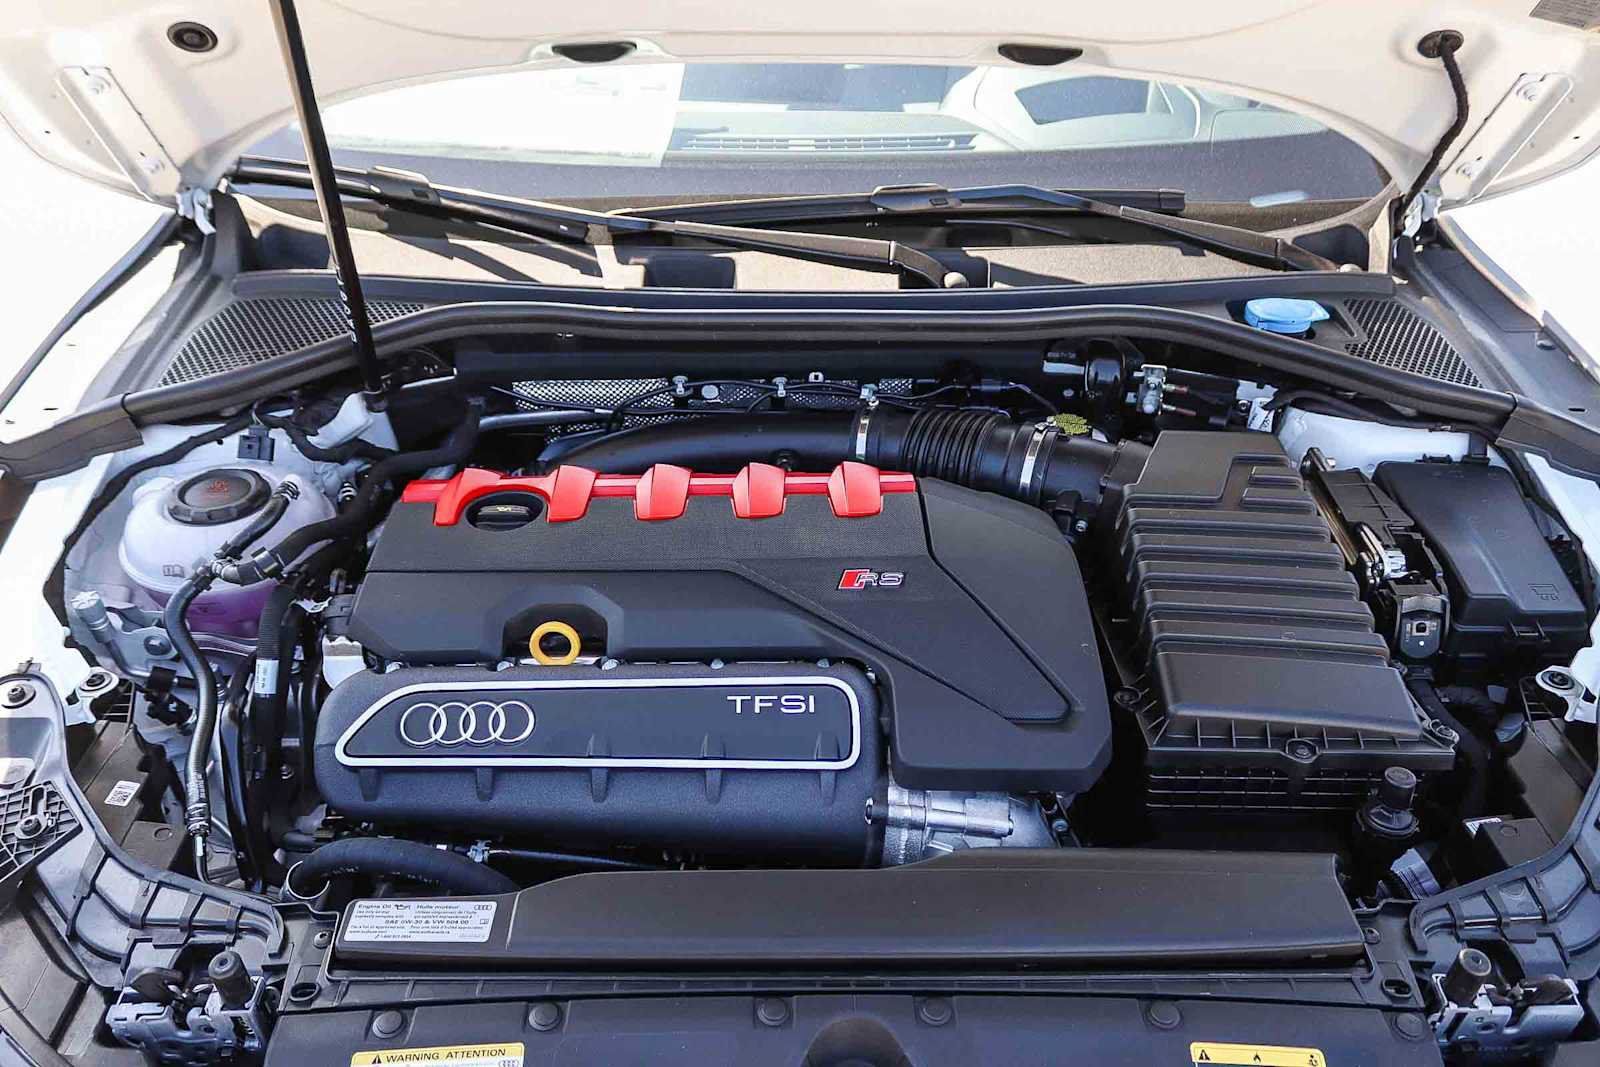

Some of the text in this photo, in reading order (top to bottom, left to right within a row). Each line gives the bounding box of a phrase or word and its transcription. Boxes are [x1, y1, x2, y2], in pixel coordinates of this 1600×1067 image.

[851, 571, 904, 587] RS
[727, 695, 815, 714] TFSI
[386, 1048, 507, 1064] WARNING ATTENTION
